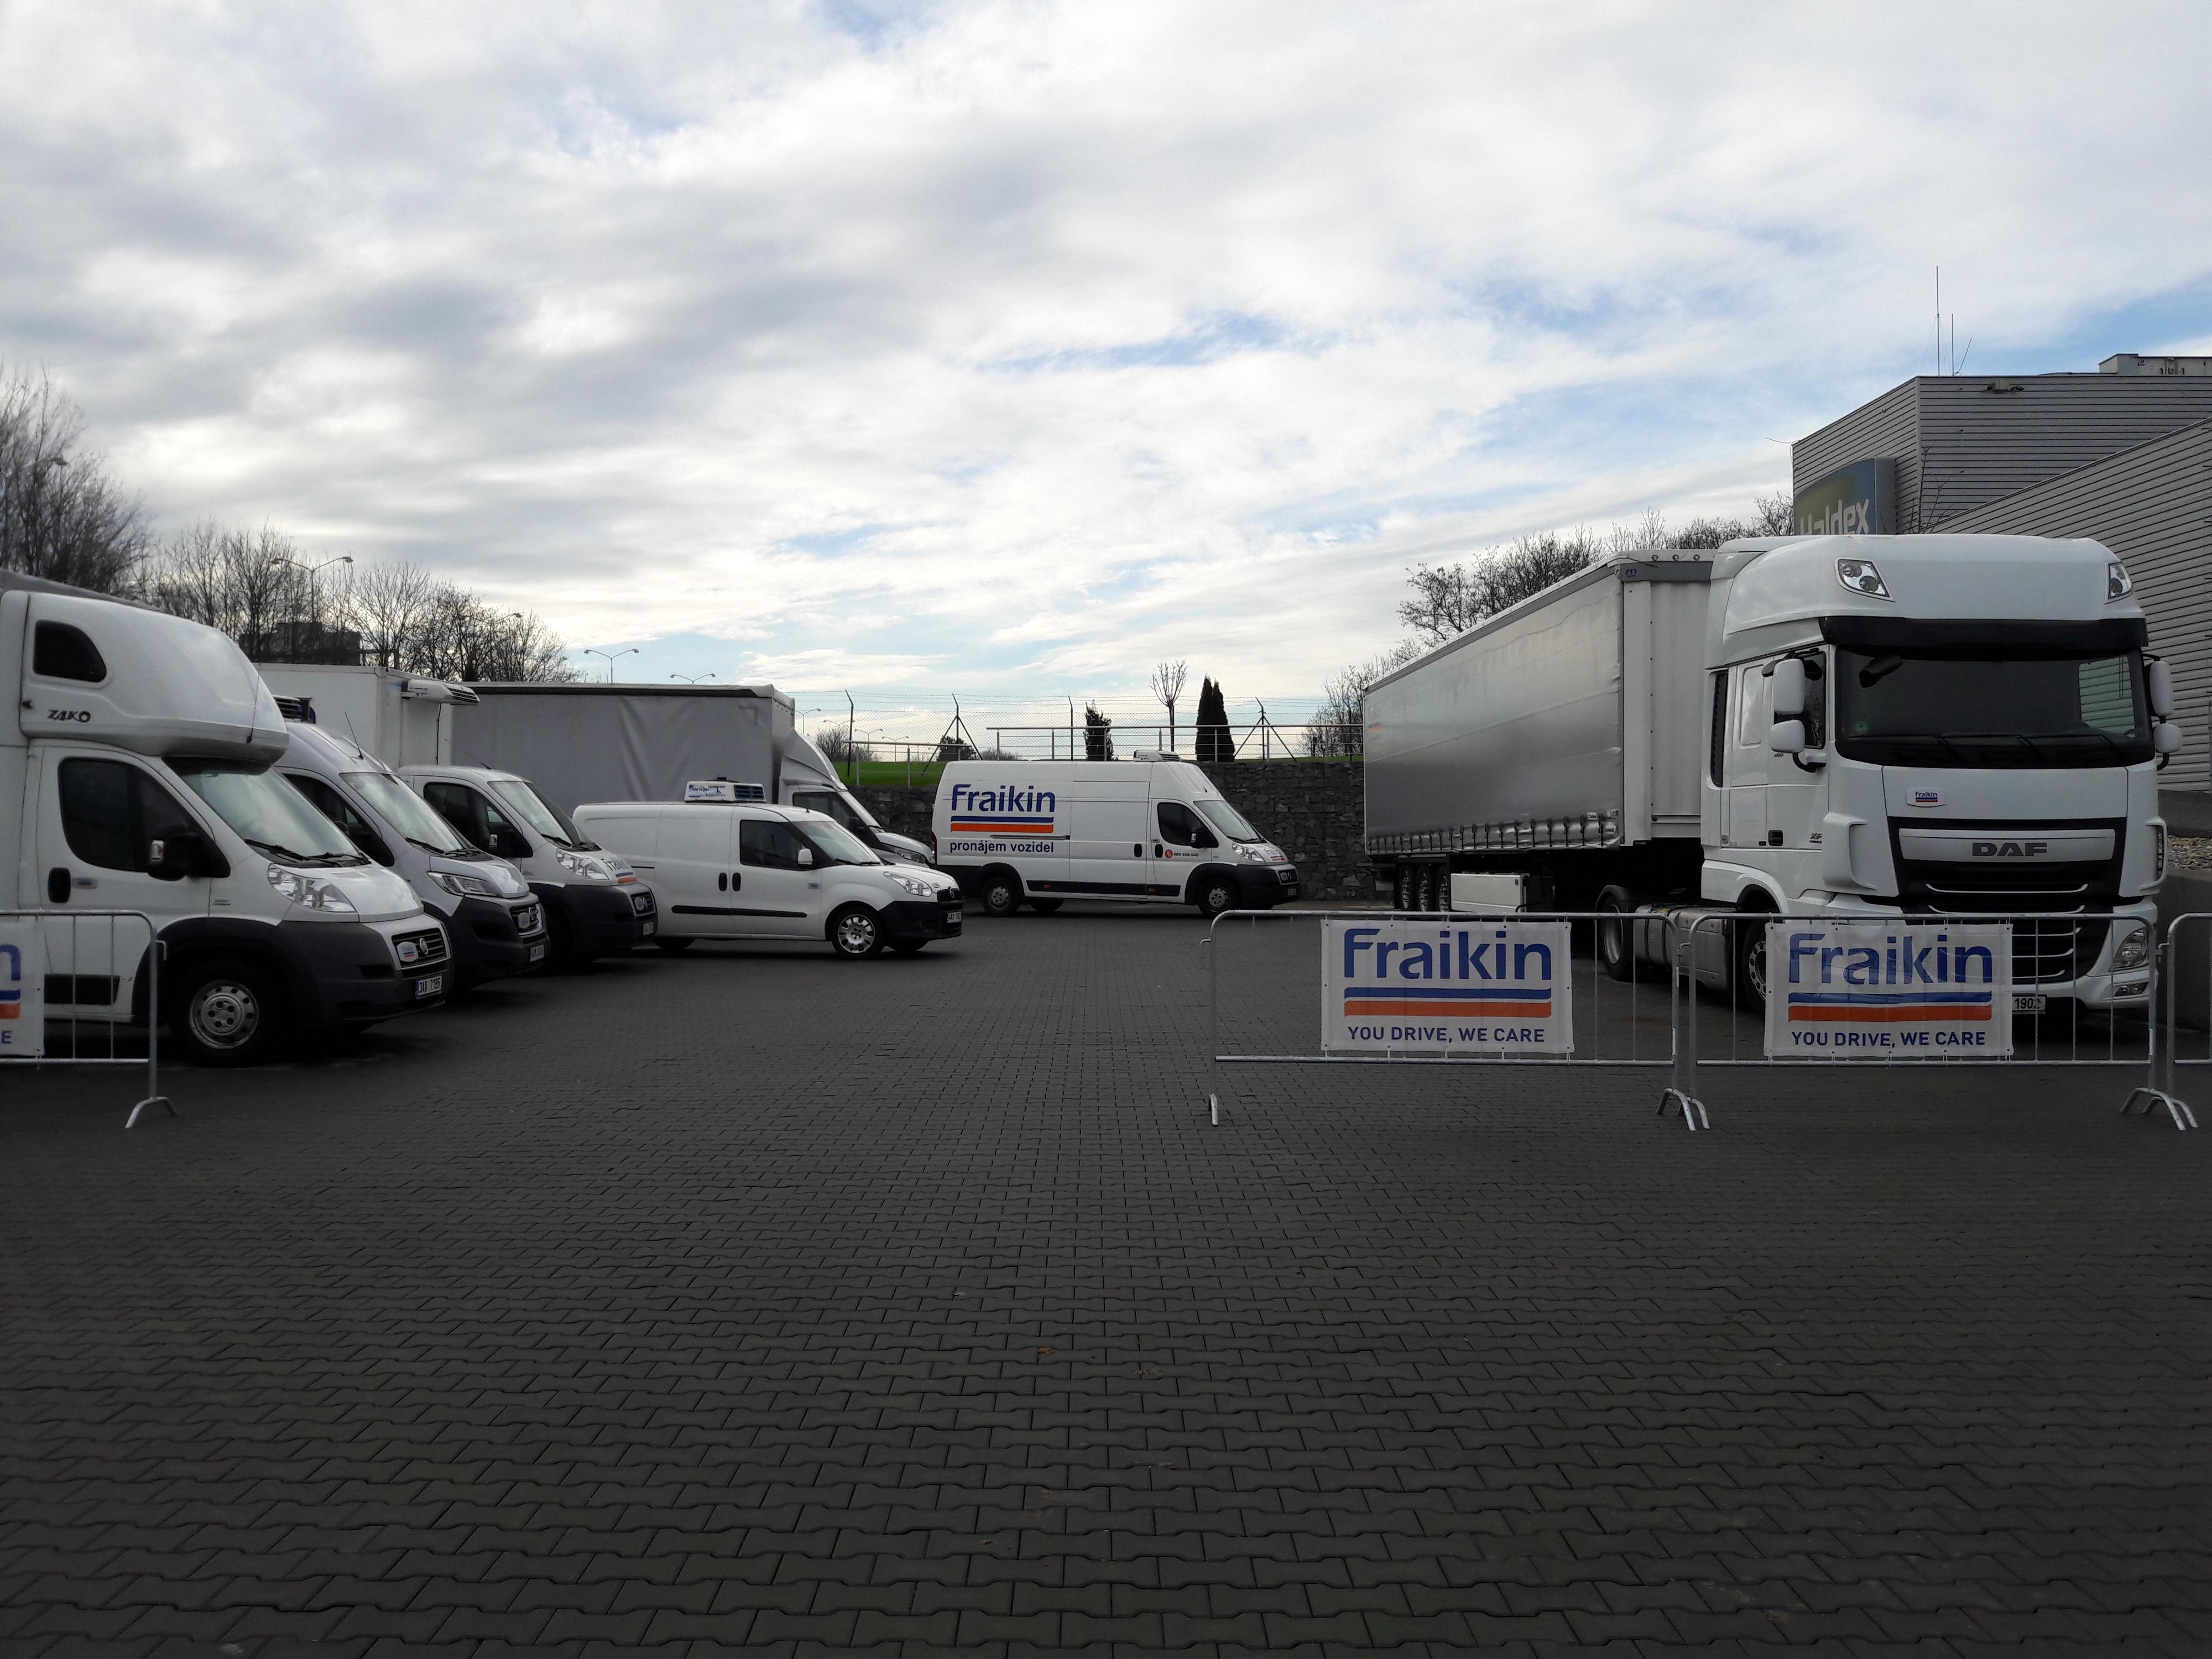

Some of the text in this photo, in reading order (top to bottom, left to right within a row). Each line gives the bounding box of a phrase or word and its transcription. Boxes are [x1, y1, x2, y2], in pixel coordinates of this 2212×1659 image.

[952, 784, 1055, 812] Fraikin
[950, 841, 1053, 854] pronájem vozidel
[1973, 843, 2047, 856] DAF
[1344, 928, 1552, 980] Fraikin
[1789, 933, 1992, 985] Fraikin
[1348, 1026, 1545, 1044] YOU DRIVE, WE CARE
[1792, 1031, 1986, 1048] YOU DRIVE, WE CARE
